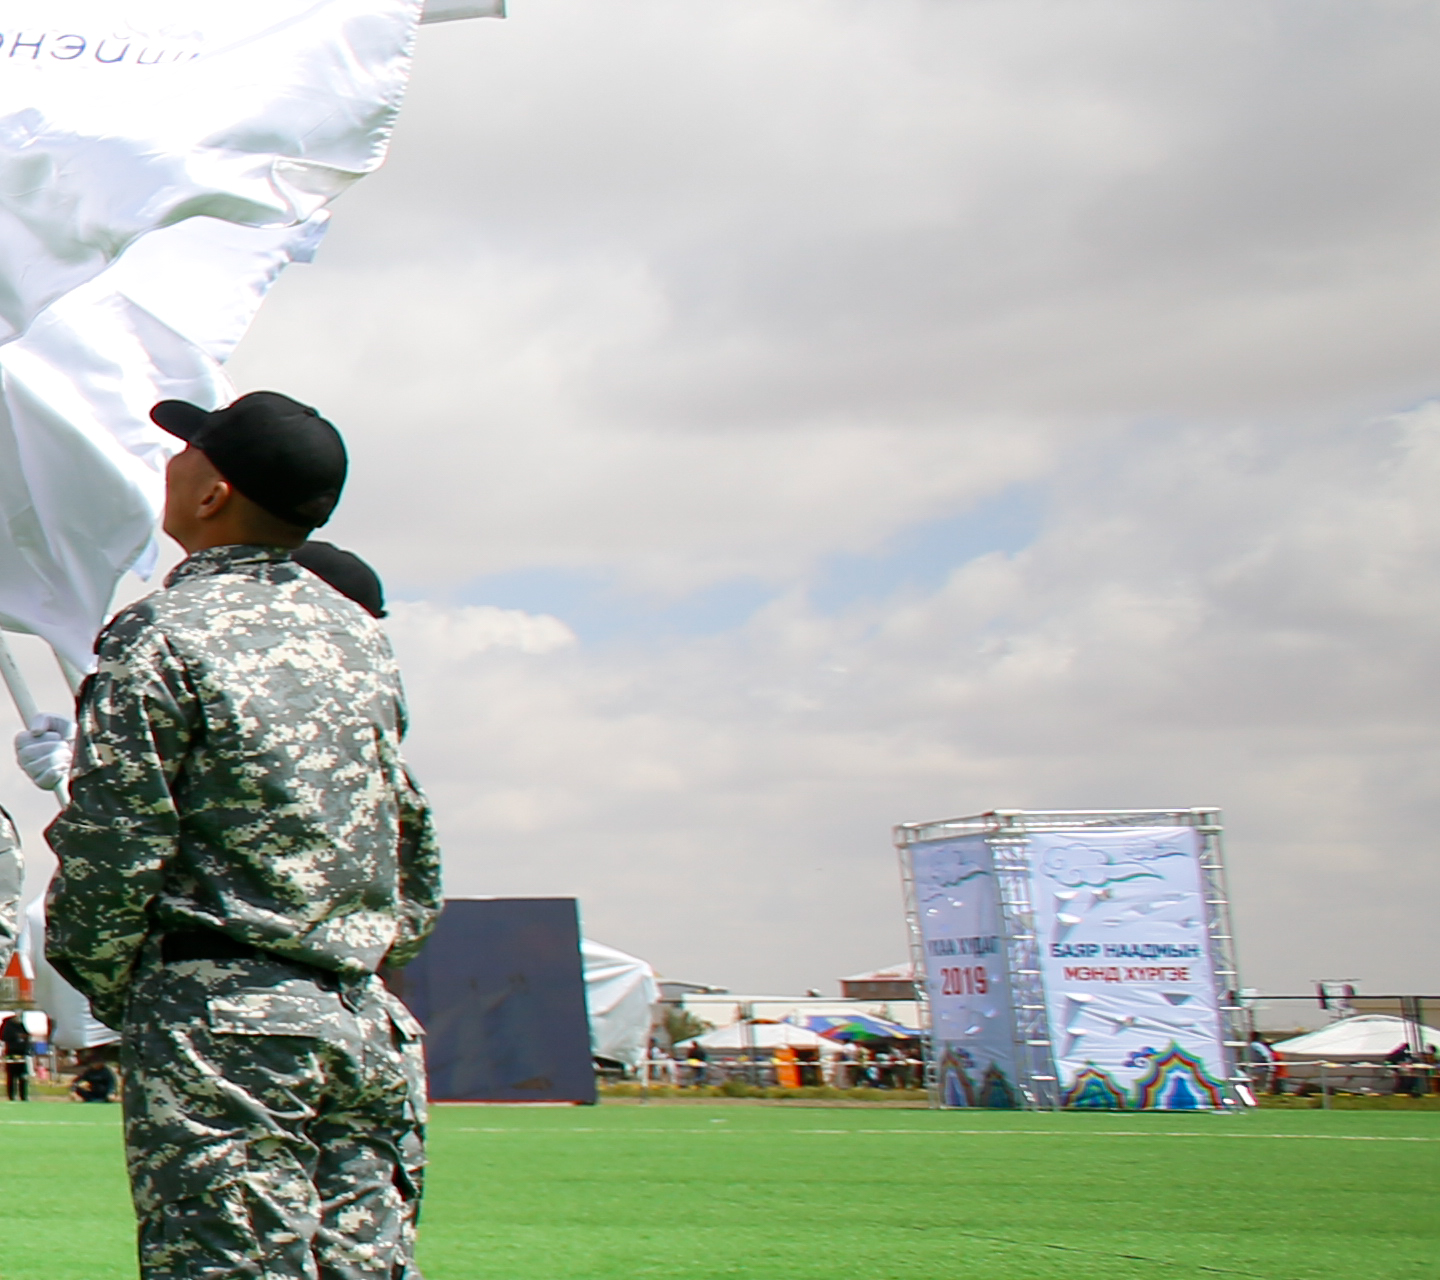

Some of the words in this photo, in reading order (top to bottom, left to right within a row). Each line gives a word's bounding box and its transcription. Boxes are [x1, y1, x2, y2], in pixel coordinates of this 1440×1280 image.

[1050, 943, 1100, 958] БАЯР
[1103, 944, 1202, 960] НААДМЫН
[941, 966, 988, 995] 2019
[1063, 967, 1121, 983] МЭНД
